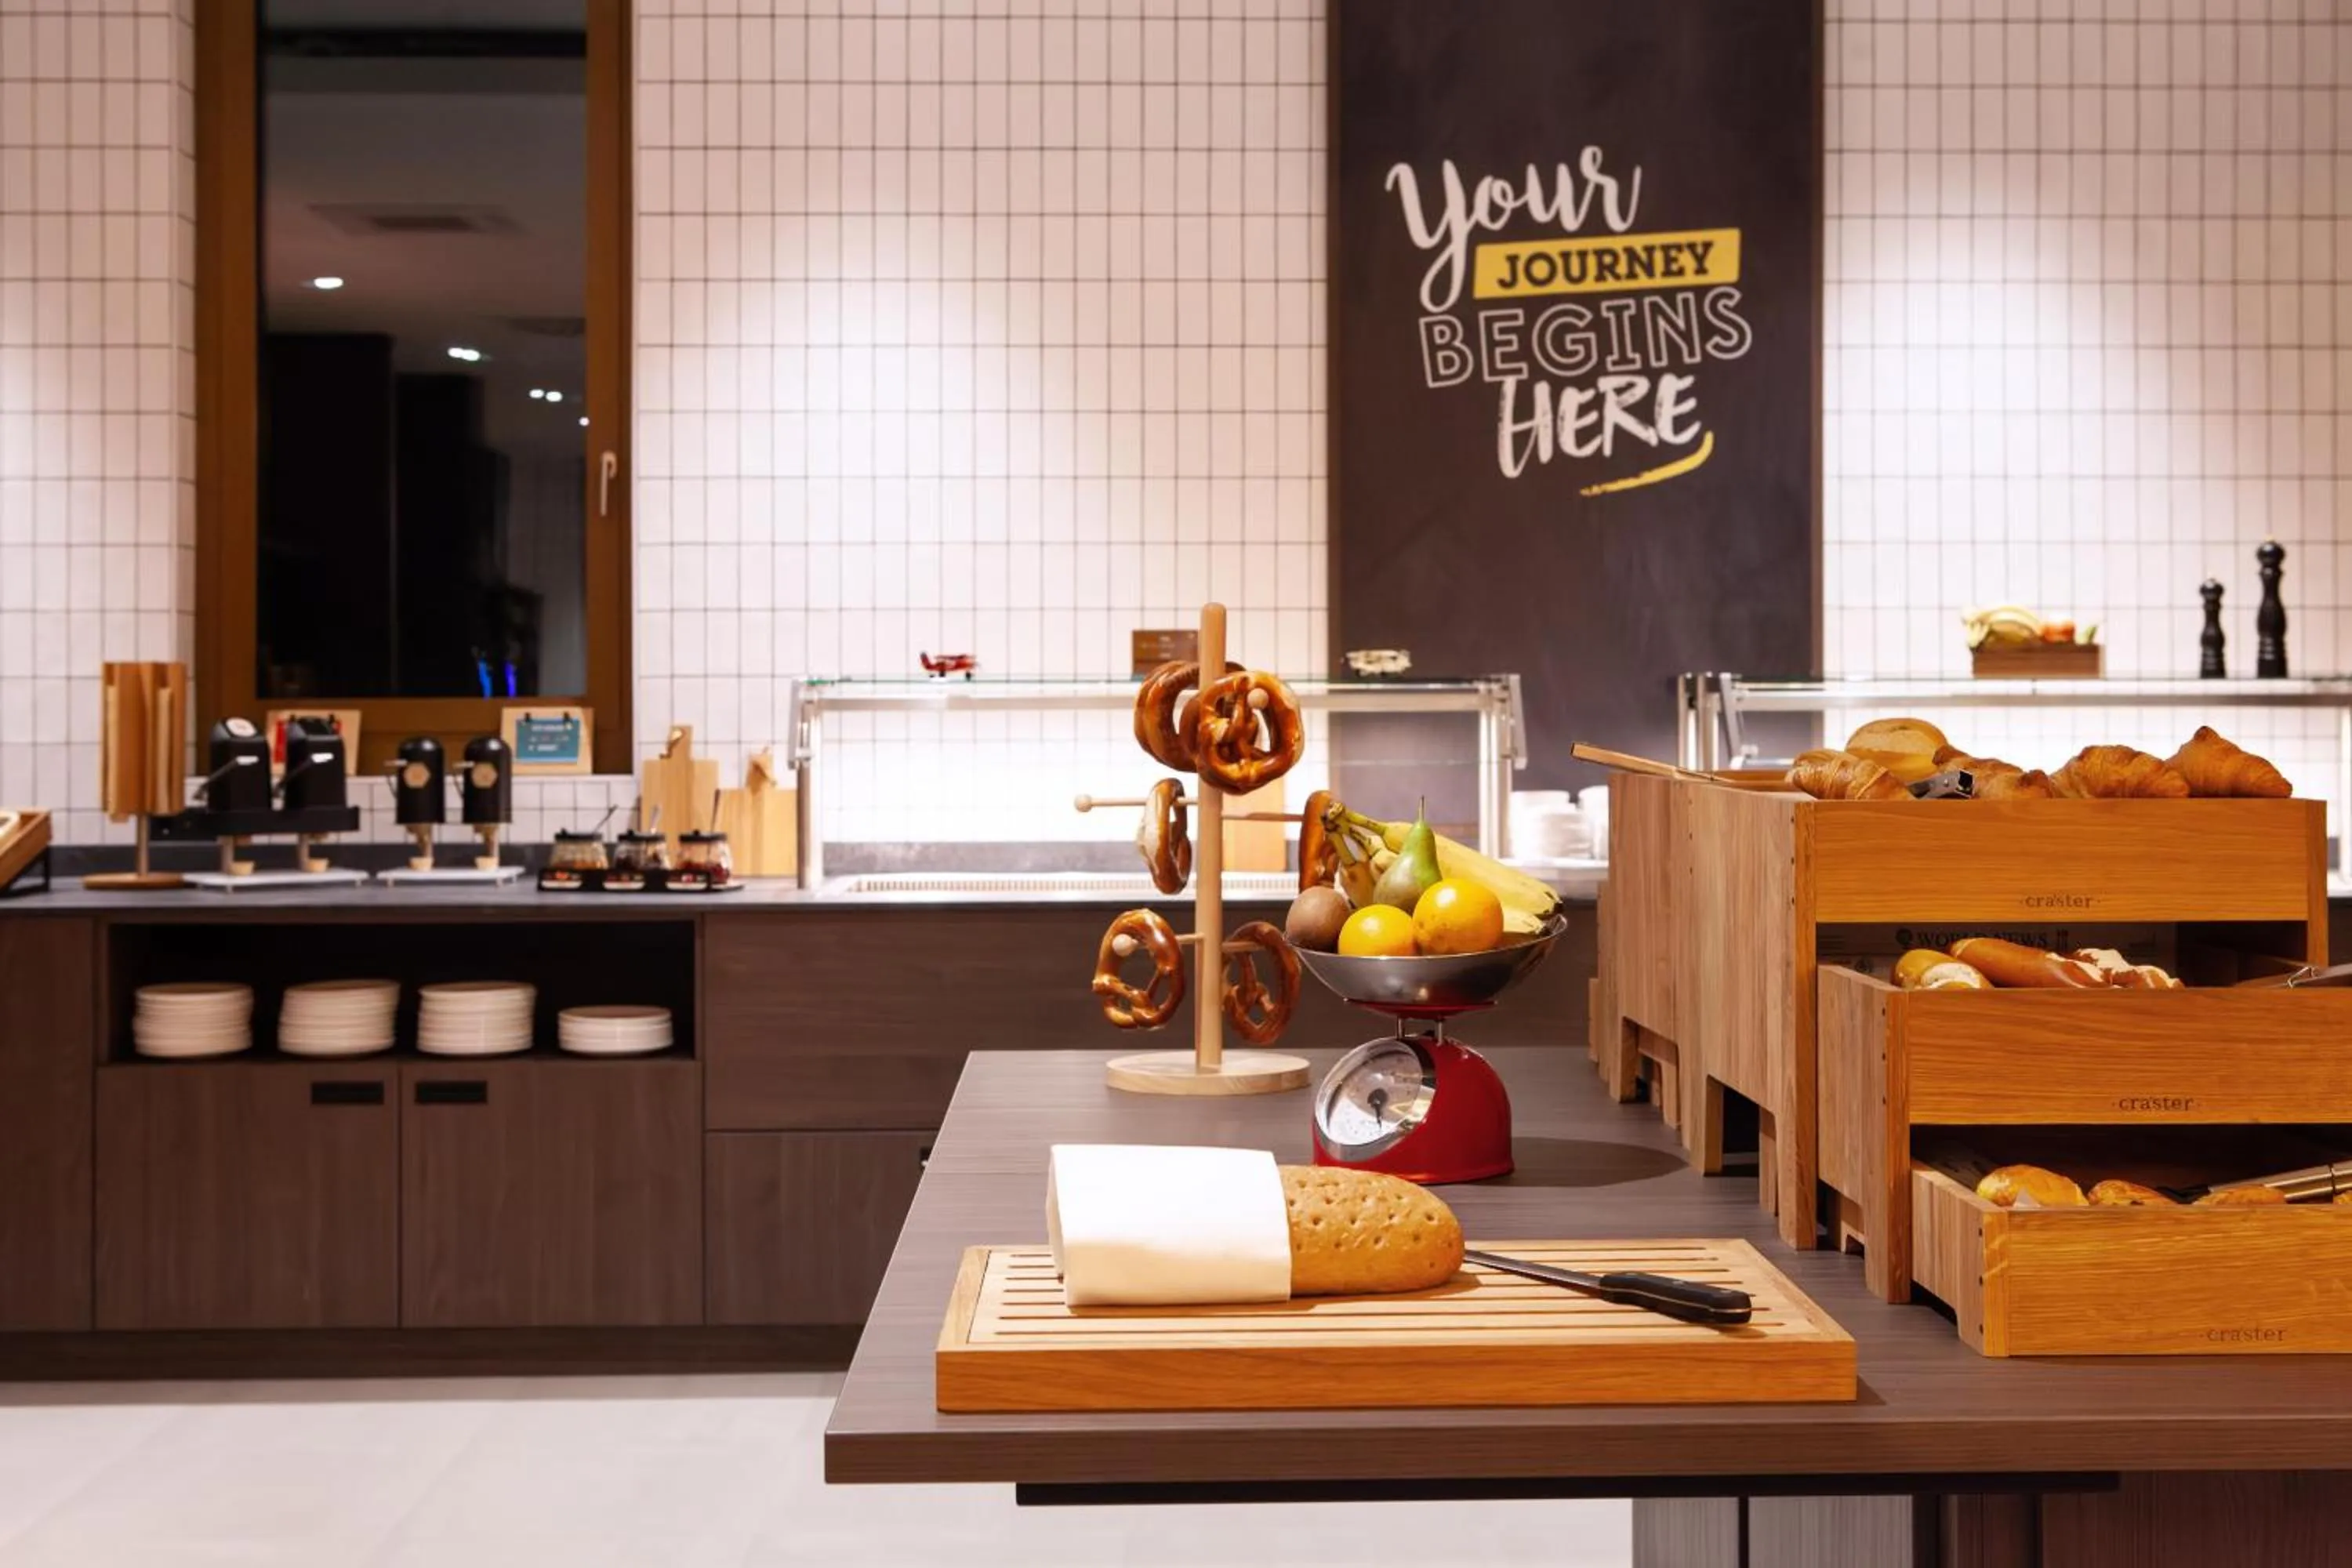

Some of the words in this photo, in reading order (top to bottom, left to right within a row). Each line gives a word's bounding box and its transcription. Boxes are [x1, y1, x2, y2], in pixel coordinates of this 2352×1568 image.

[1386, 147, 1641, 312] Your
[1496, 240, 1715, 290] JOURNEY
[1420, 287, 1752, 388] BEGINS
[1497, 374, 1701, 478] HERE
